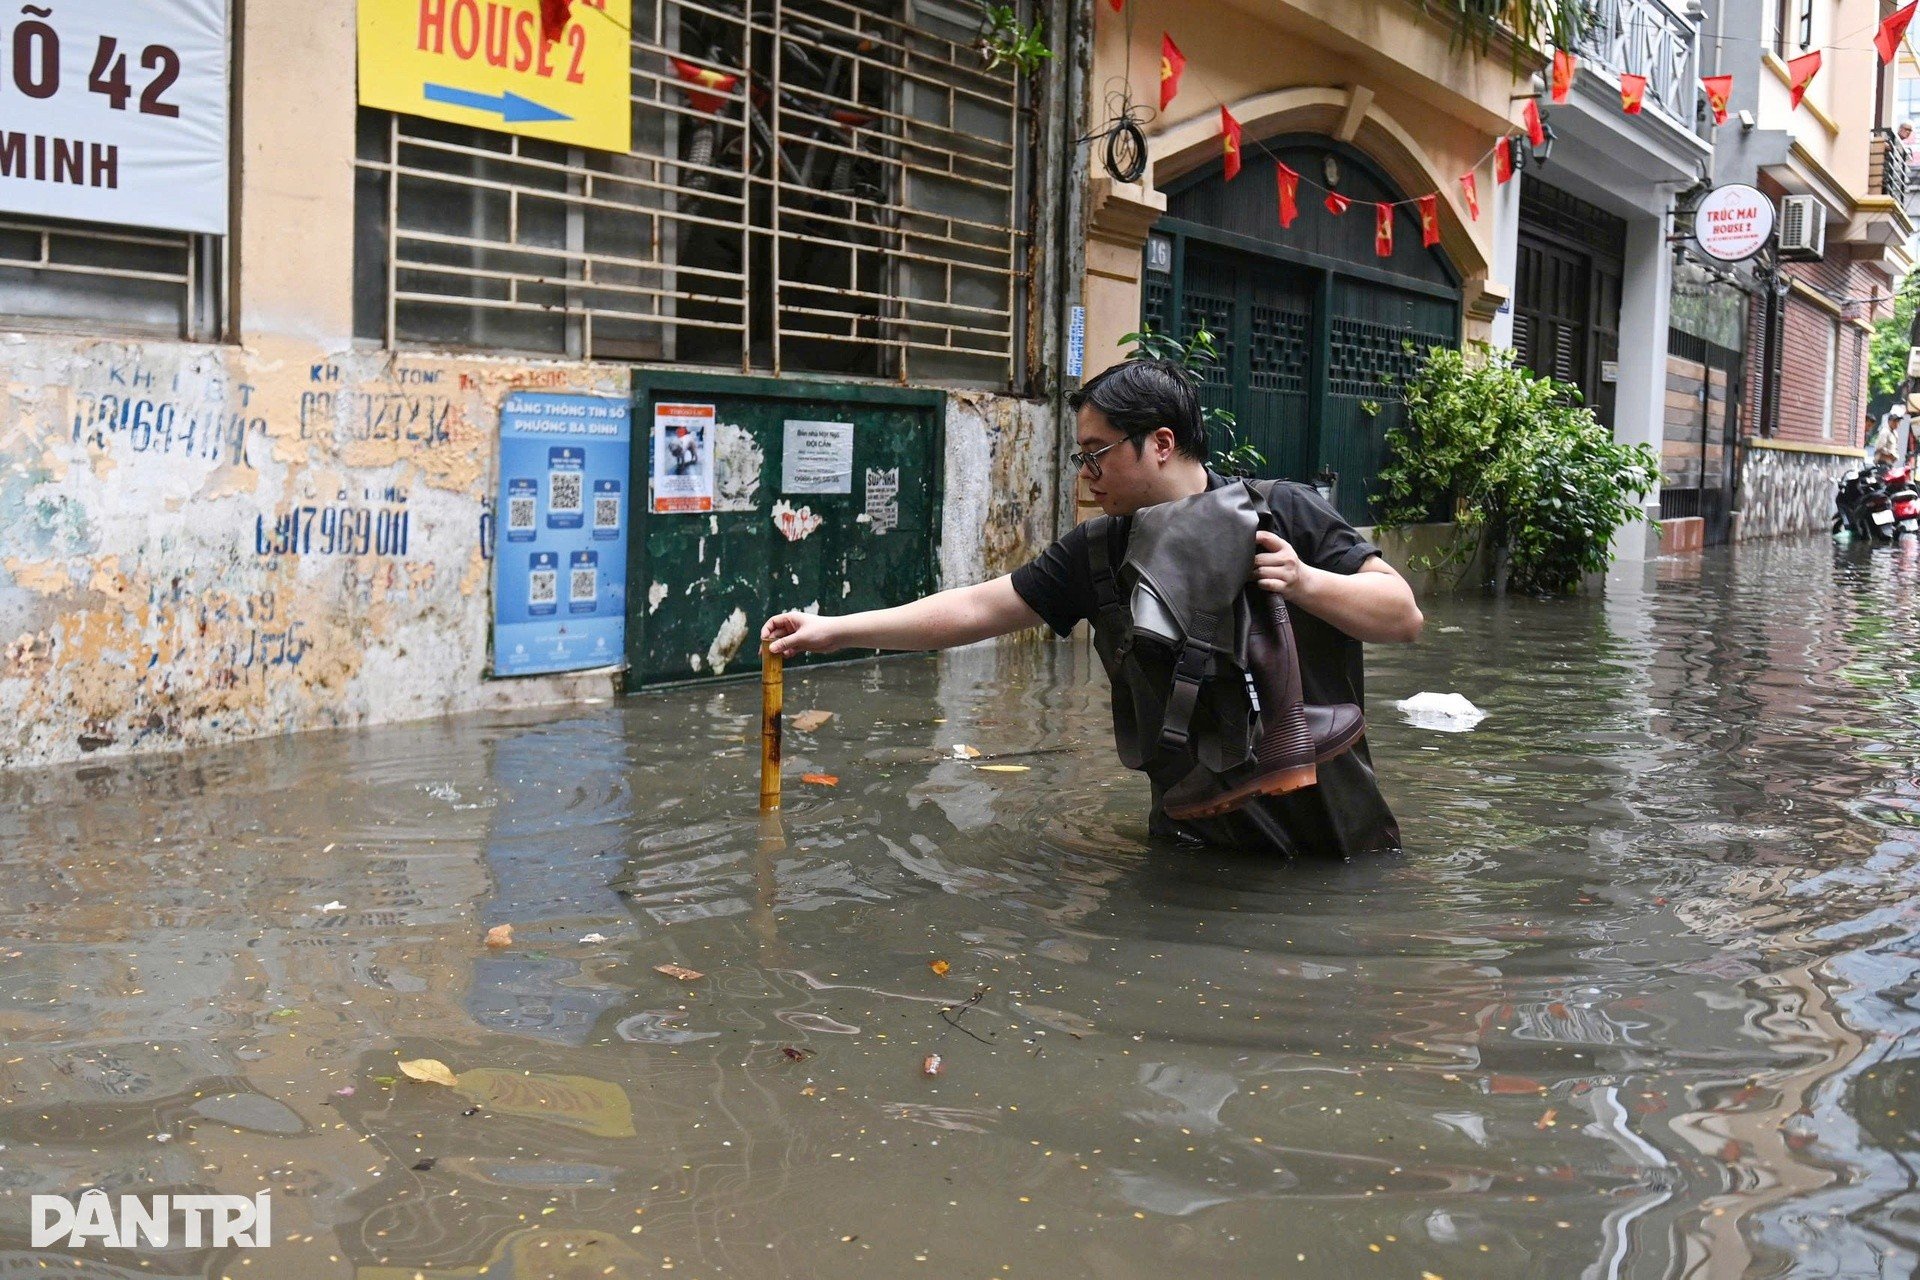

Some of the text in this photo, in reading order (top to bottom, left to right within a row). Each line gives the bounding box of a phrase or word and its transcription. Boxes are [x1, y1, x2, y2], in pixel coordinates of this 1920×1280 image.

[566, 23, 586, 84] 2
[88, 35, 180, 118] 42
[1707, 207, 1758, 222] TRÚC MAI
[1712, 223, 1744, 234] HOUSE
[1150, 239, 1167, 265] 16
[544, 402, 586, 417] THÔNG
[589, 406, 608, 418] TIN
[609, 405, 626, 419] SỐ
[569, 421, 586, 434] BA
